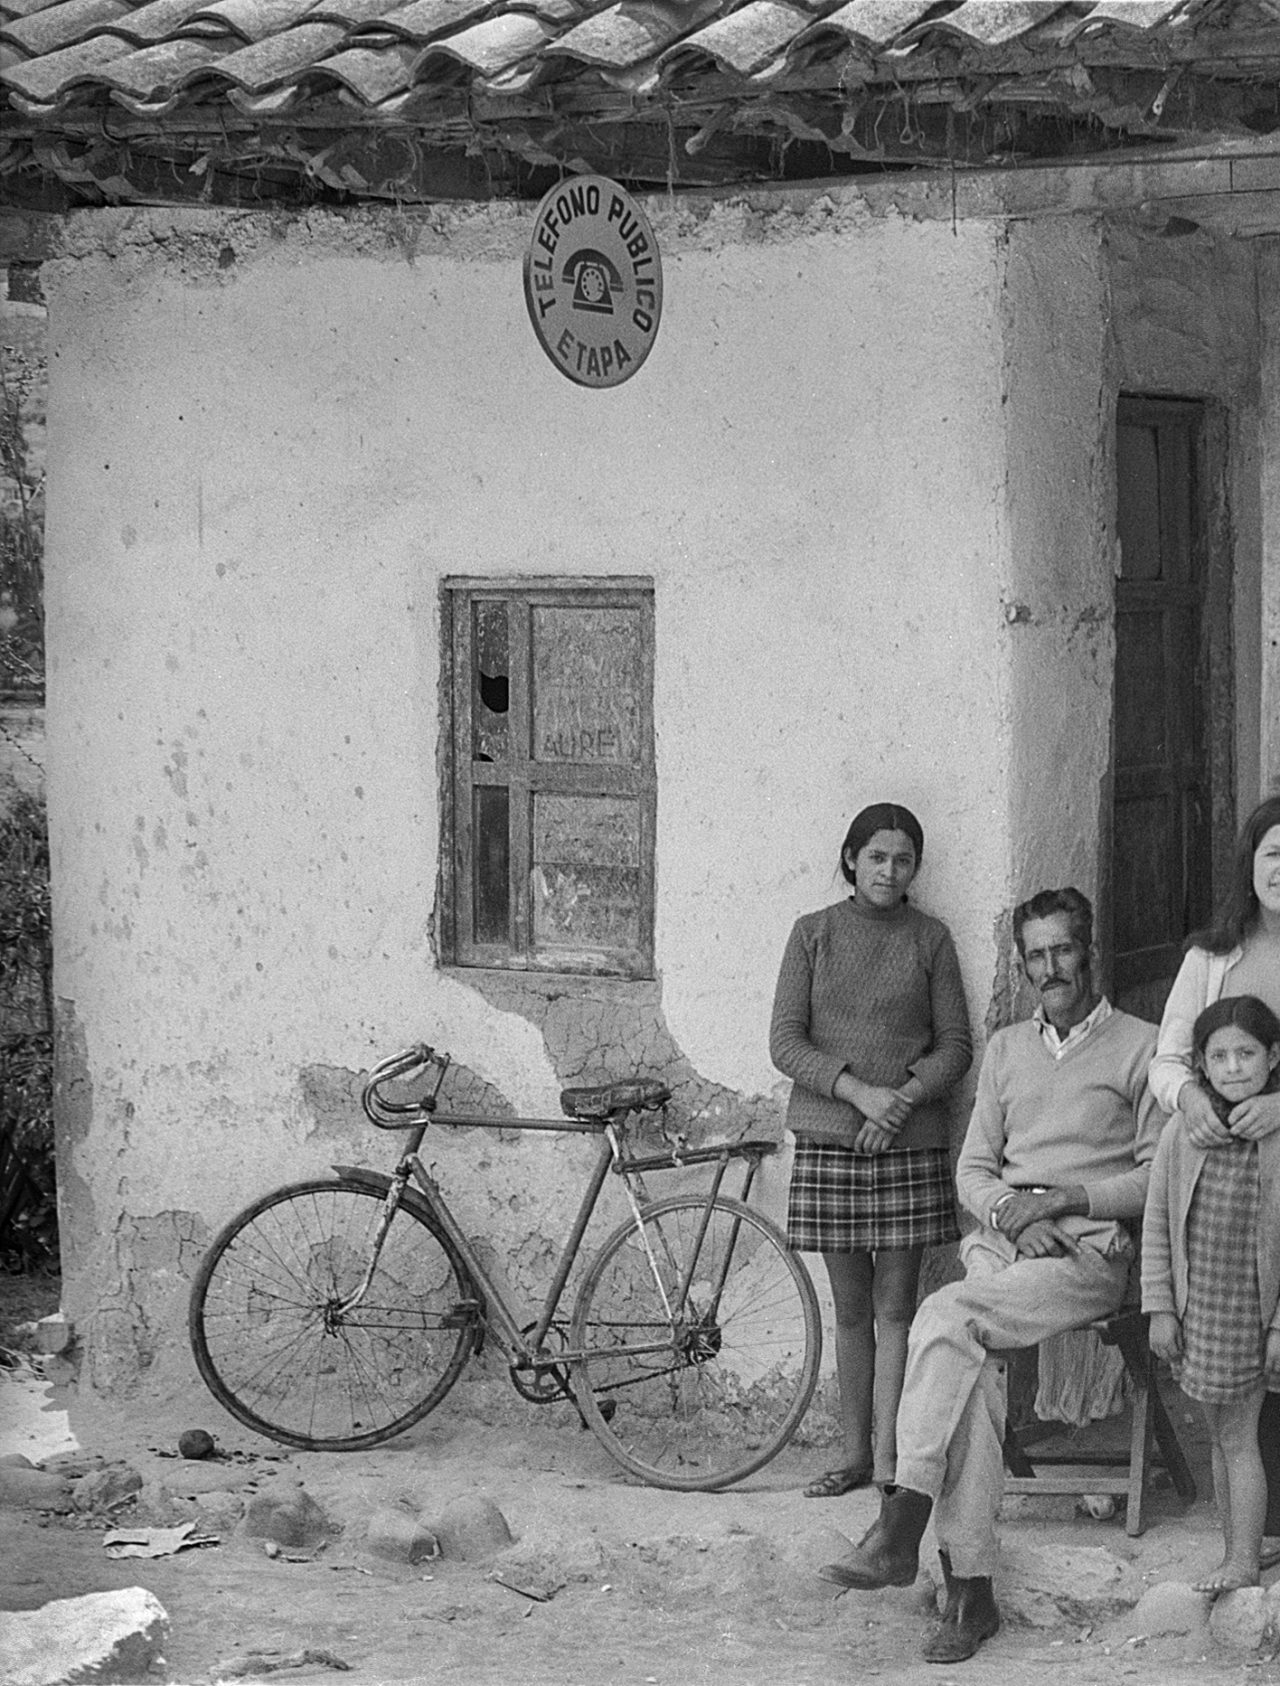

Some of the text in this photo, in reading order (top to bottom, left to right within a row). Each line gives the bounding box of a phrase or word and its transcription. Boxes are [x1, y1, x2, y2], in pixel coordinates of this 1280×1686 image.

[534, 185, 655, 333] TELEFONO PUBLICO
[556, 328, 631, 376] ETAPA
